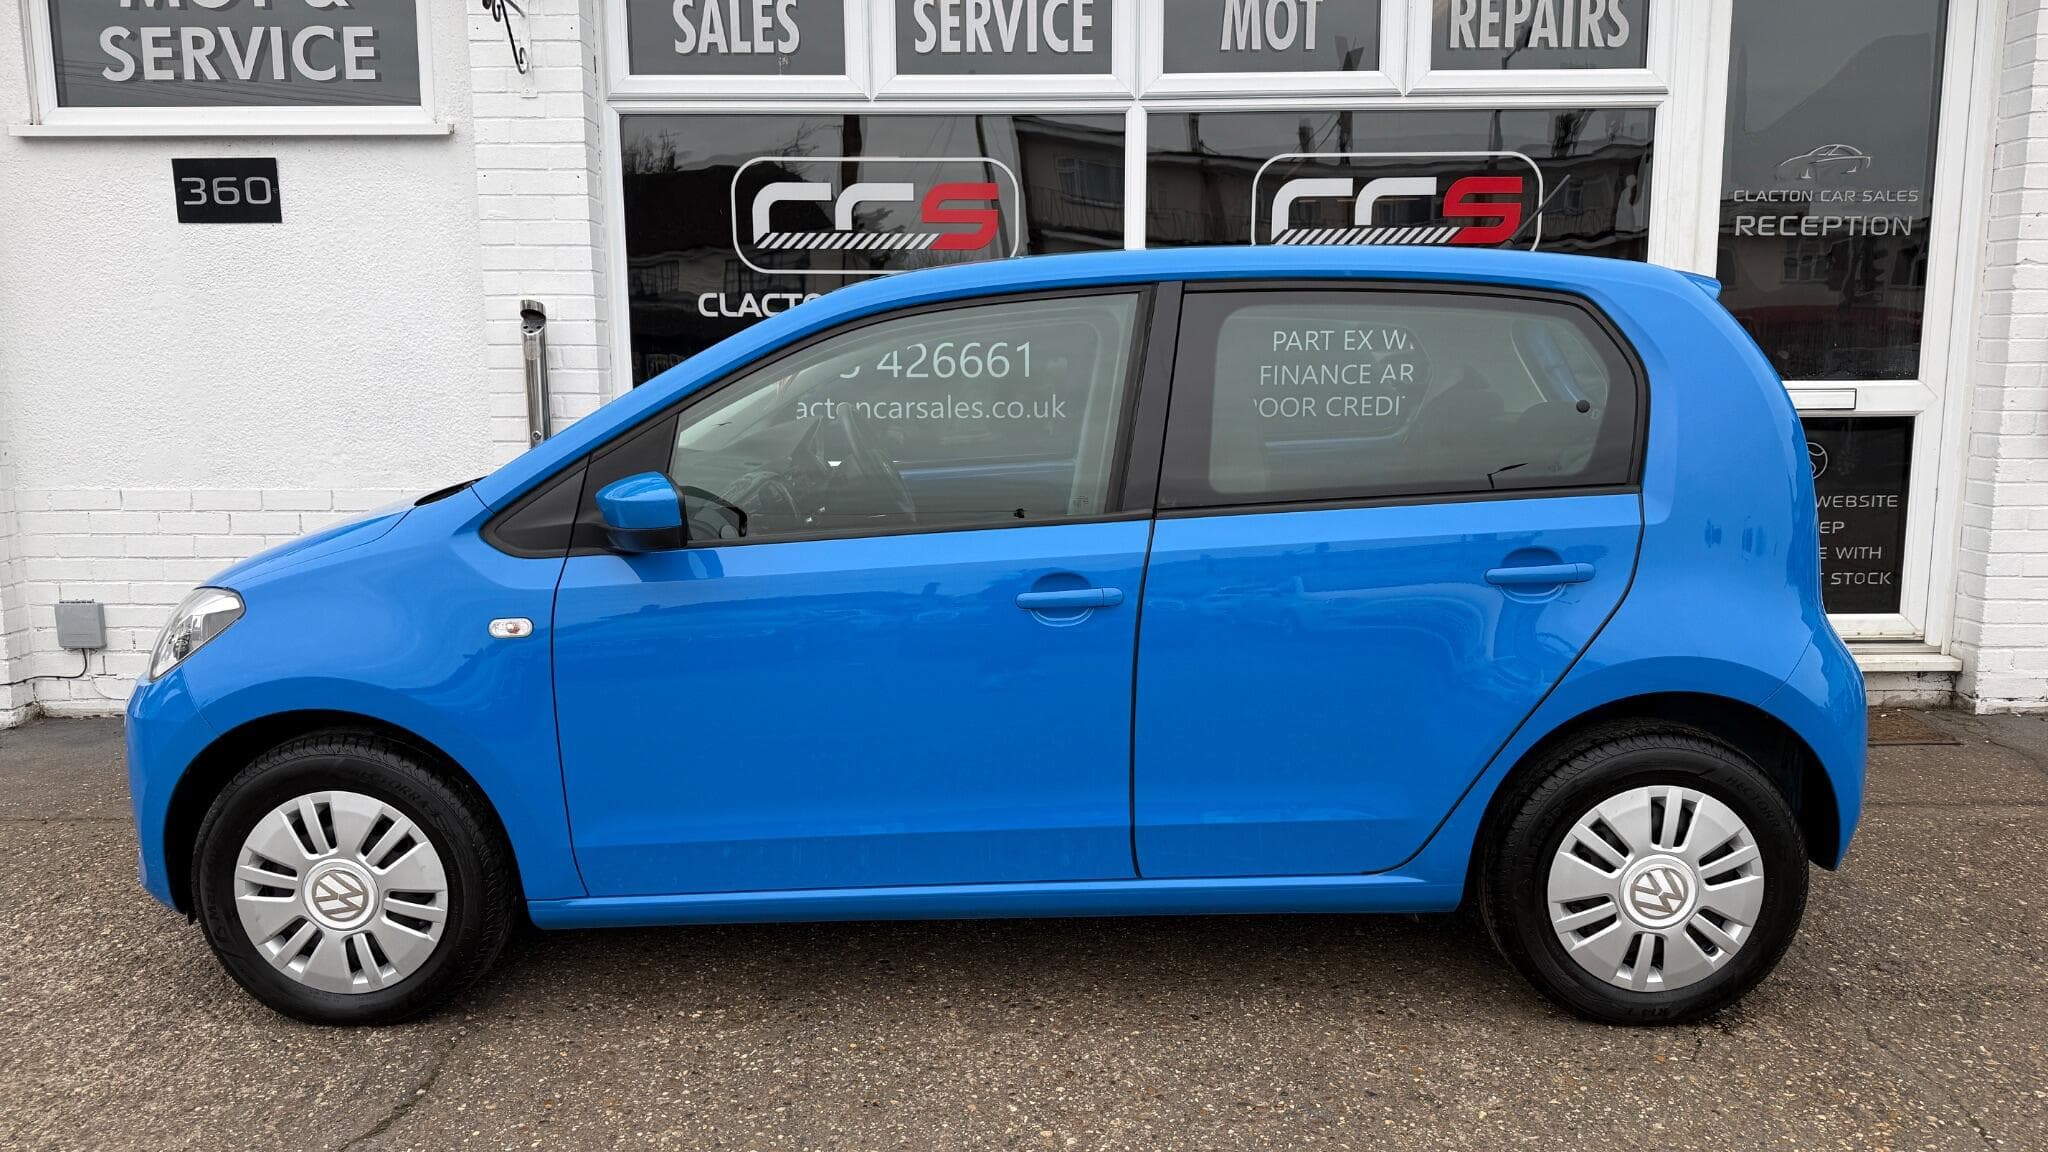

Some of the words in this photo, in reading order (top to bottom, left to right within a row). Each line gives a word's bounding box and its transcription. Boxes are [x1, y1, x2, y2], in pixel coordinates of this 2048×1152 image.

[673, 0, 800, 54] SALES
[914, 0, 1093, 53] SERVICE
[1220, 0, 1322, 51] MOT
[1449, 0, 1631, 49] REPAIRS
[99, 25, 376, 82] SERVICE
[181, 177, 272, 206] 360
[1734, 190, 1813, 202] CLACTON
[1820, 190, 1856, 202] CAR
[1862, 190, 1919, 202] SALES
[1735, 215, 1912, 236] RECEPTION
[1273, 330, 1335, 351] PART
[1344, 329, 1373, 350] EX
[876, 341, 1032, 379] 426661
[1260, 364, 1371, 386] FINANCE
[1253, 396, 1317, 418] OOR
[1326, 395, 1406, 417] CREDI
[1816, 495, 1899, 508] WEBSITE
[1819, 521, 1845, 534] EP
[1835, 546, 1882, 560] WITH
[1830, 572, 1892, 585] STOCK
